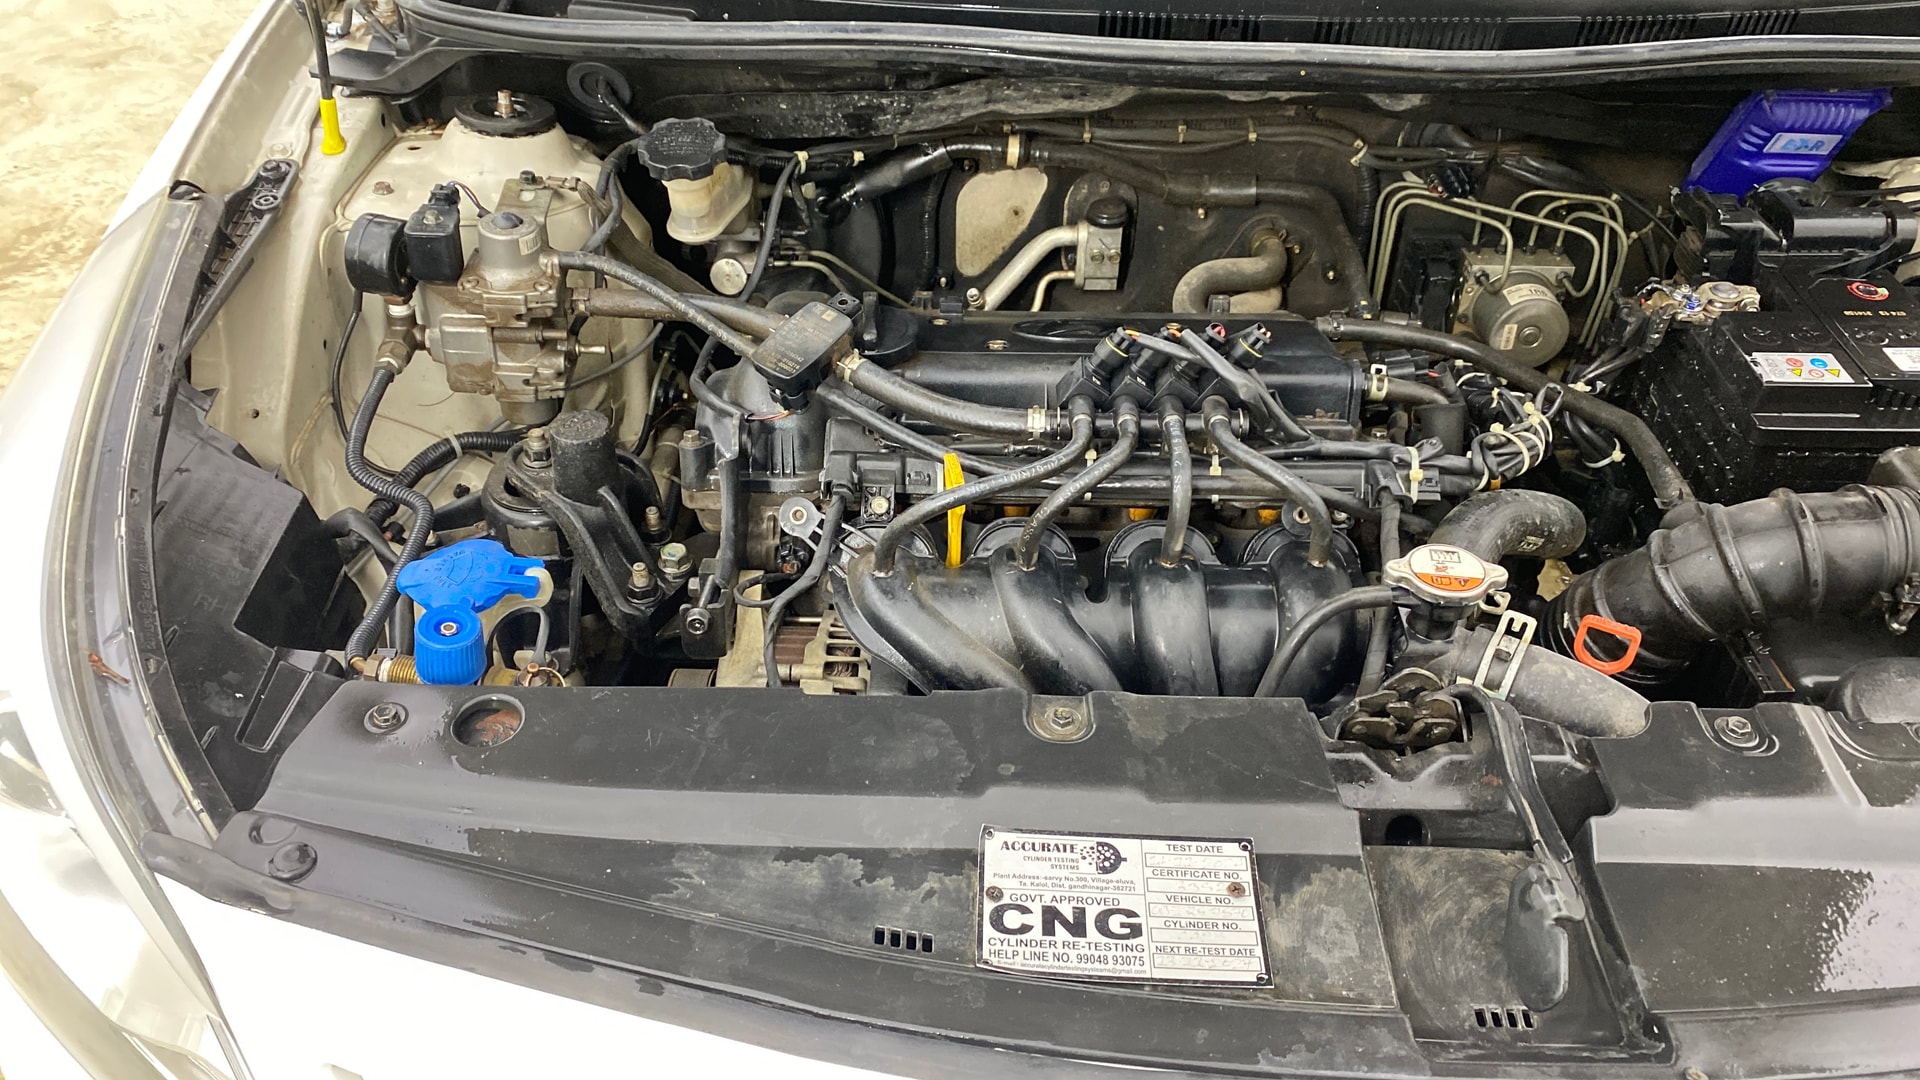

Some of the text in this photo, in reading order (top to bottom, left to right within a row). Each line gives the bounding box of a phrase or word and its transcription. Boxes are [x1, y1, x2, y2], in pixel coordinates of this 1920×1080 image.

[1023, 506, 1050, 541] CLASS
[1001, 840, 1078, 854] ACCURATE
[1166, 844, 1223, 853] TEST DATE
[1152, 869, 1242, 880] CERTIFICATE NO.
[1010, 893, 1120, 906] GOVT. APPROVED
[1166, 895, 1234, 905] VEHICLE NO.
[989, 903, 1143, 940] CNG
[1222, 922, 1241, 930] NO.
[988, 937, 1145, 953] CYLINDER RE-TESTING
[1155, 945, 1256, 956] NEXT RE-TEST DATE
[989, 949, 1145, 967] HELP LINE NO. 99048 93075
